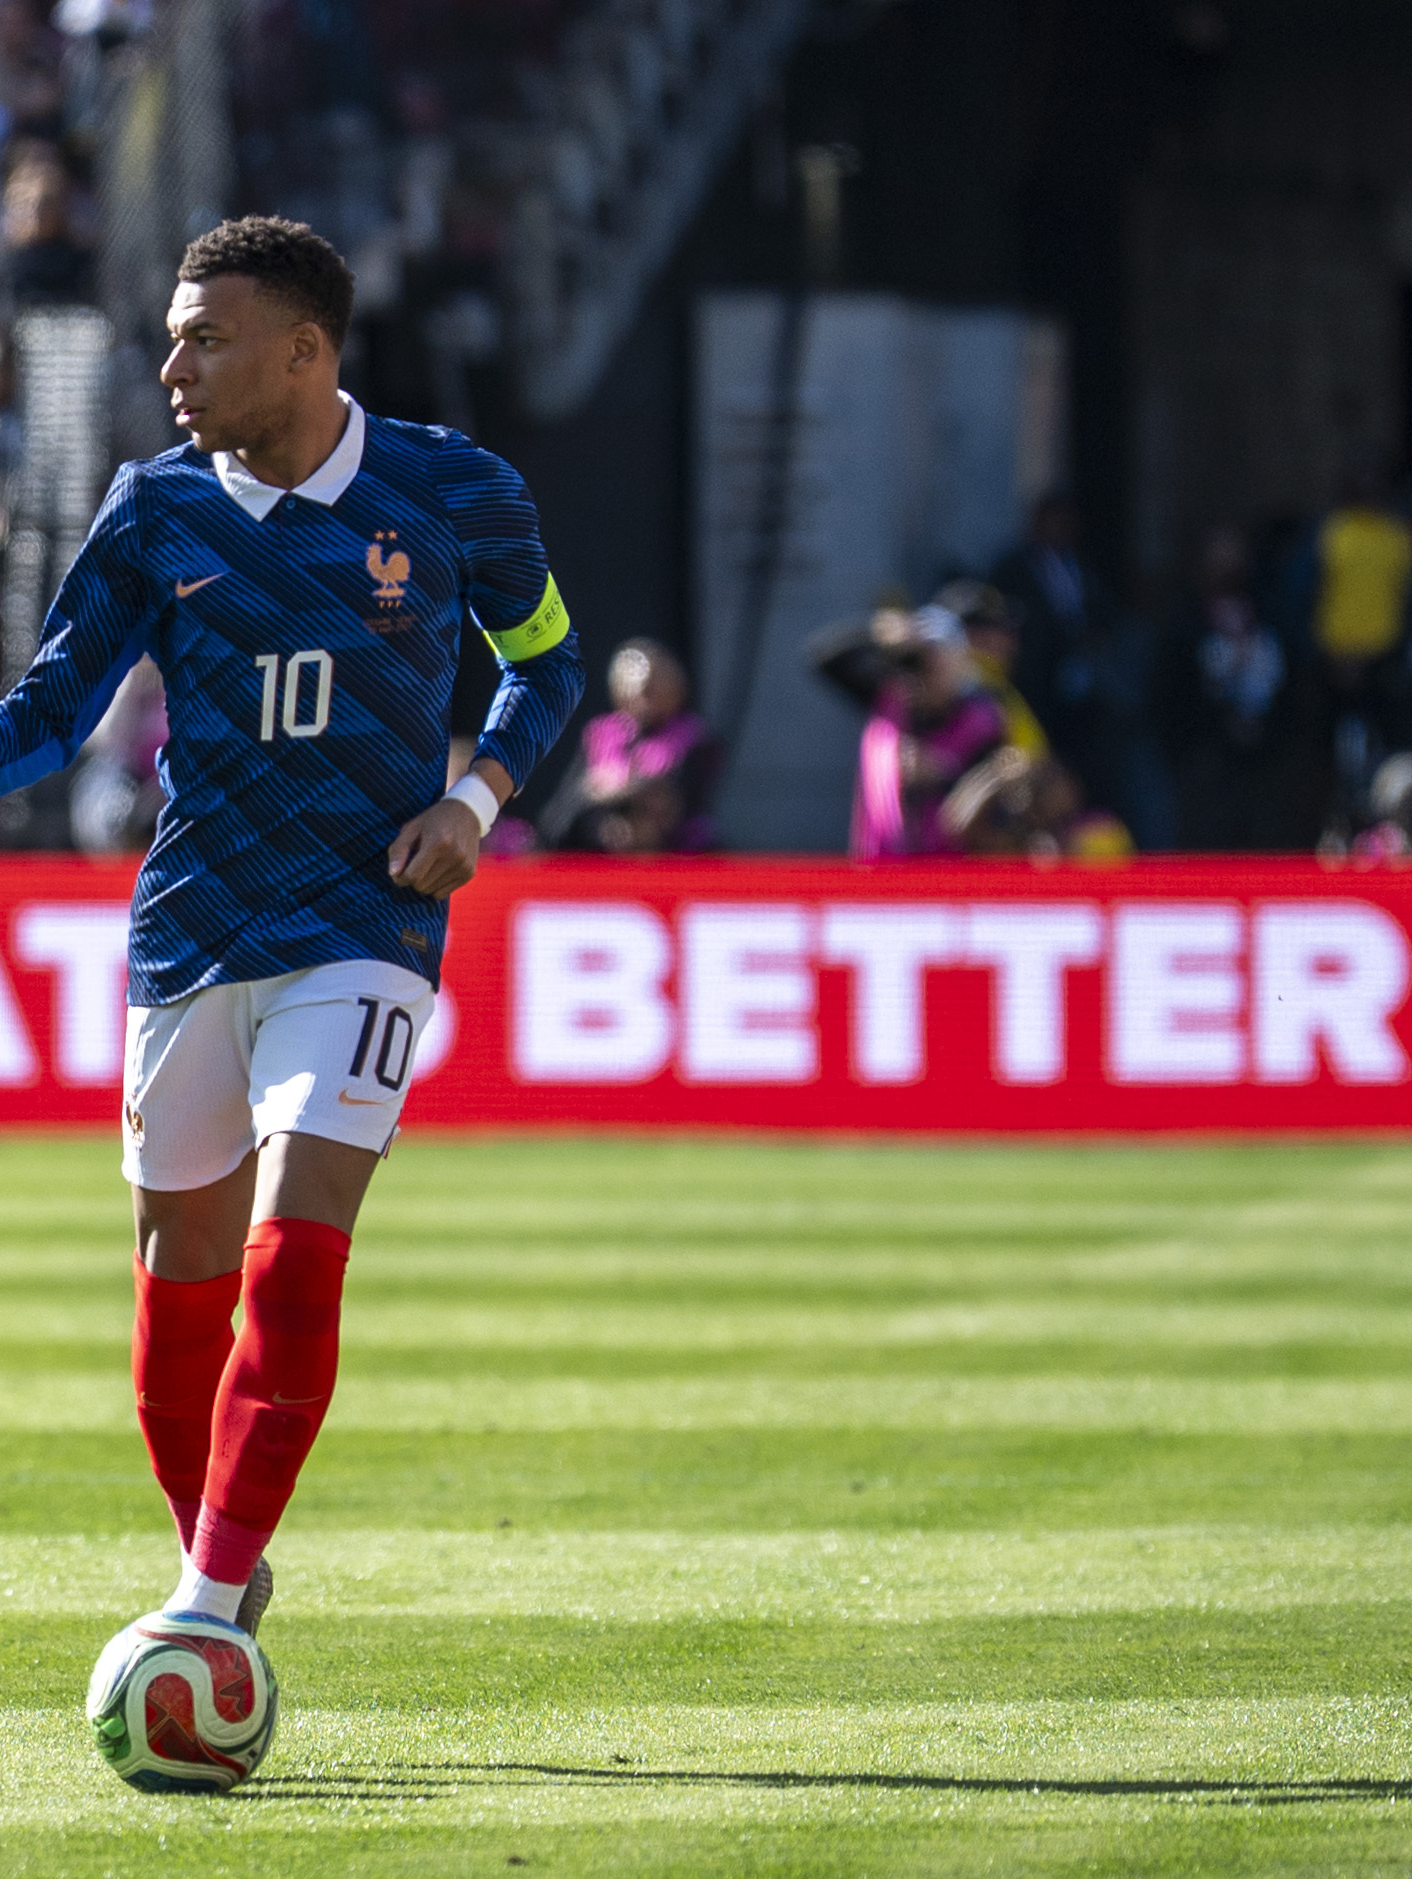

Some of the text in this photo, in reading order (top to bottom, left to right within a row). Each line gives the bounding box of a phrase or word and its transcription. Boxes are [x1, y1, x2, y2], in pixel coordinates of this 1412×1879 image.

[255, 649, 333, 741] 10
[513, 900, 1410, 1083] BETTER
[349, 997, 413, 1092] 10
